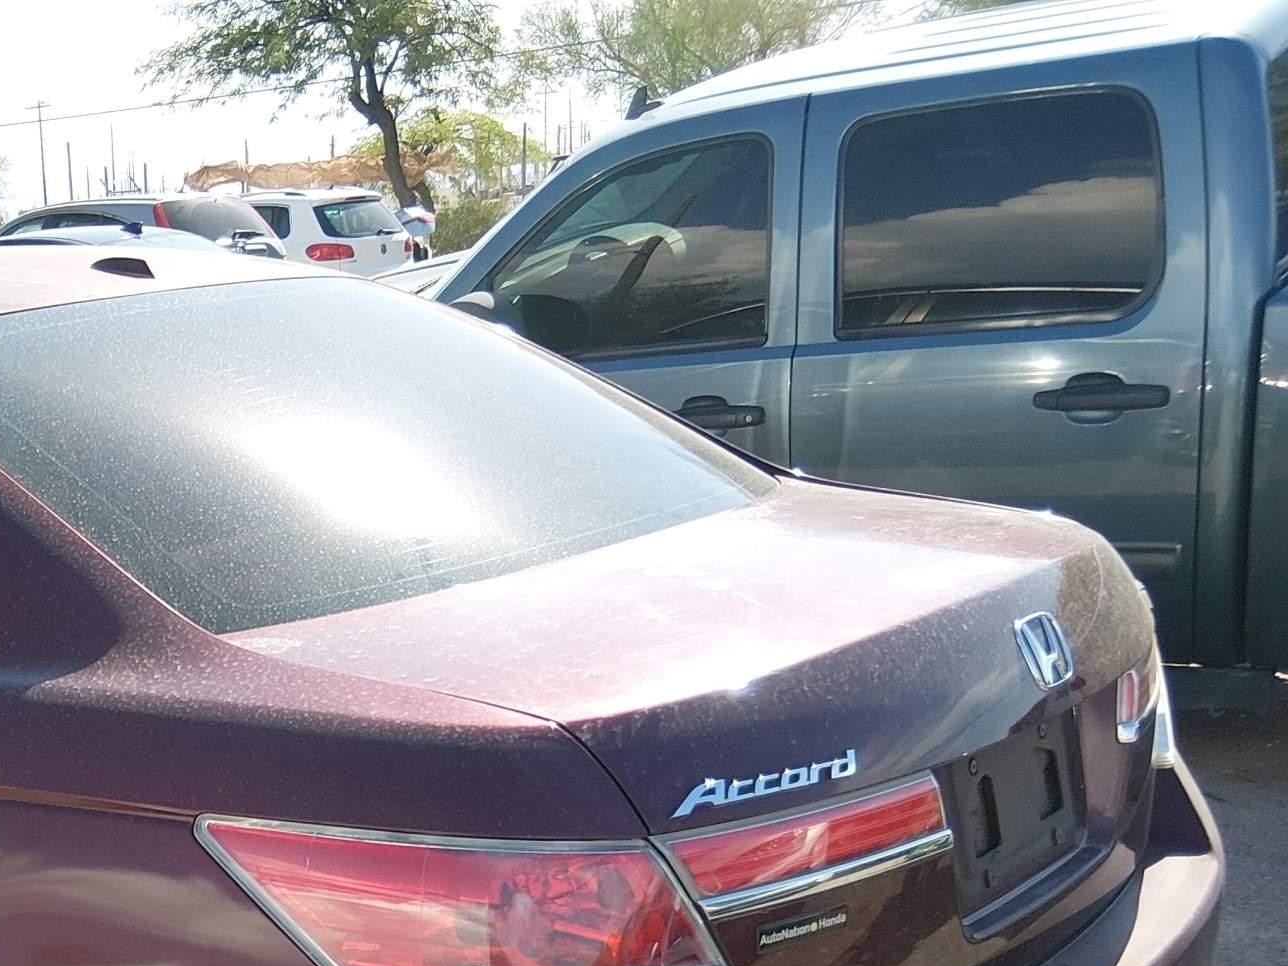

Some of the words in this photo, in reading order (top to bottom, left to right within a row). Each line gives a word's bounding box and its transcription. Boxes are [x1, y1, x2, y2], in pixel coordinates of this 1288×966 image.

[669, 747, 859, 819] Accord
[759, 921, 811, 948] AutoNation
[818, 911, 847, 933] Honda
